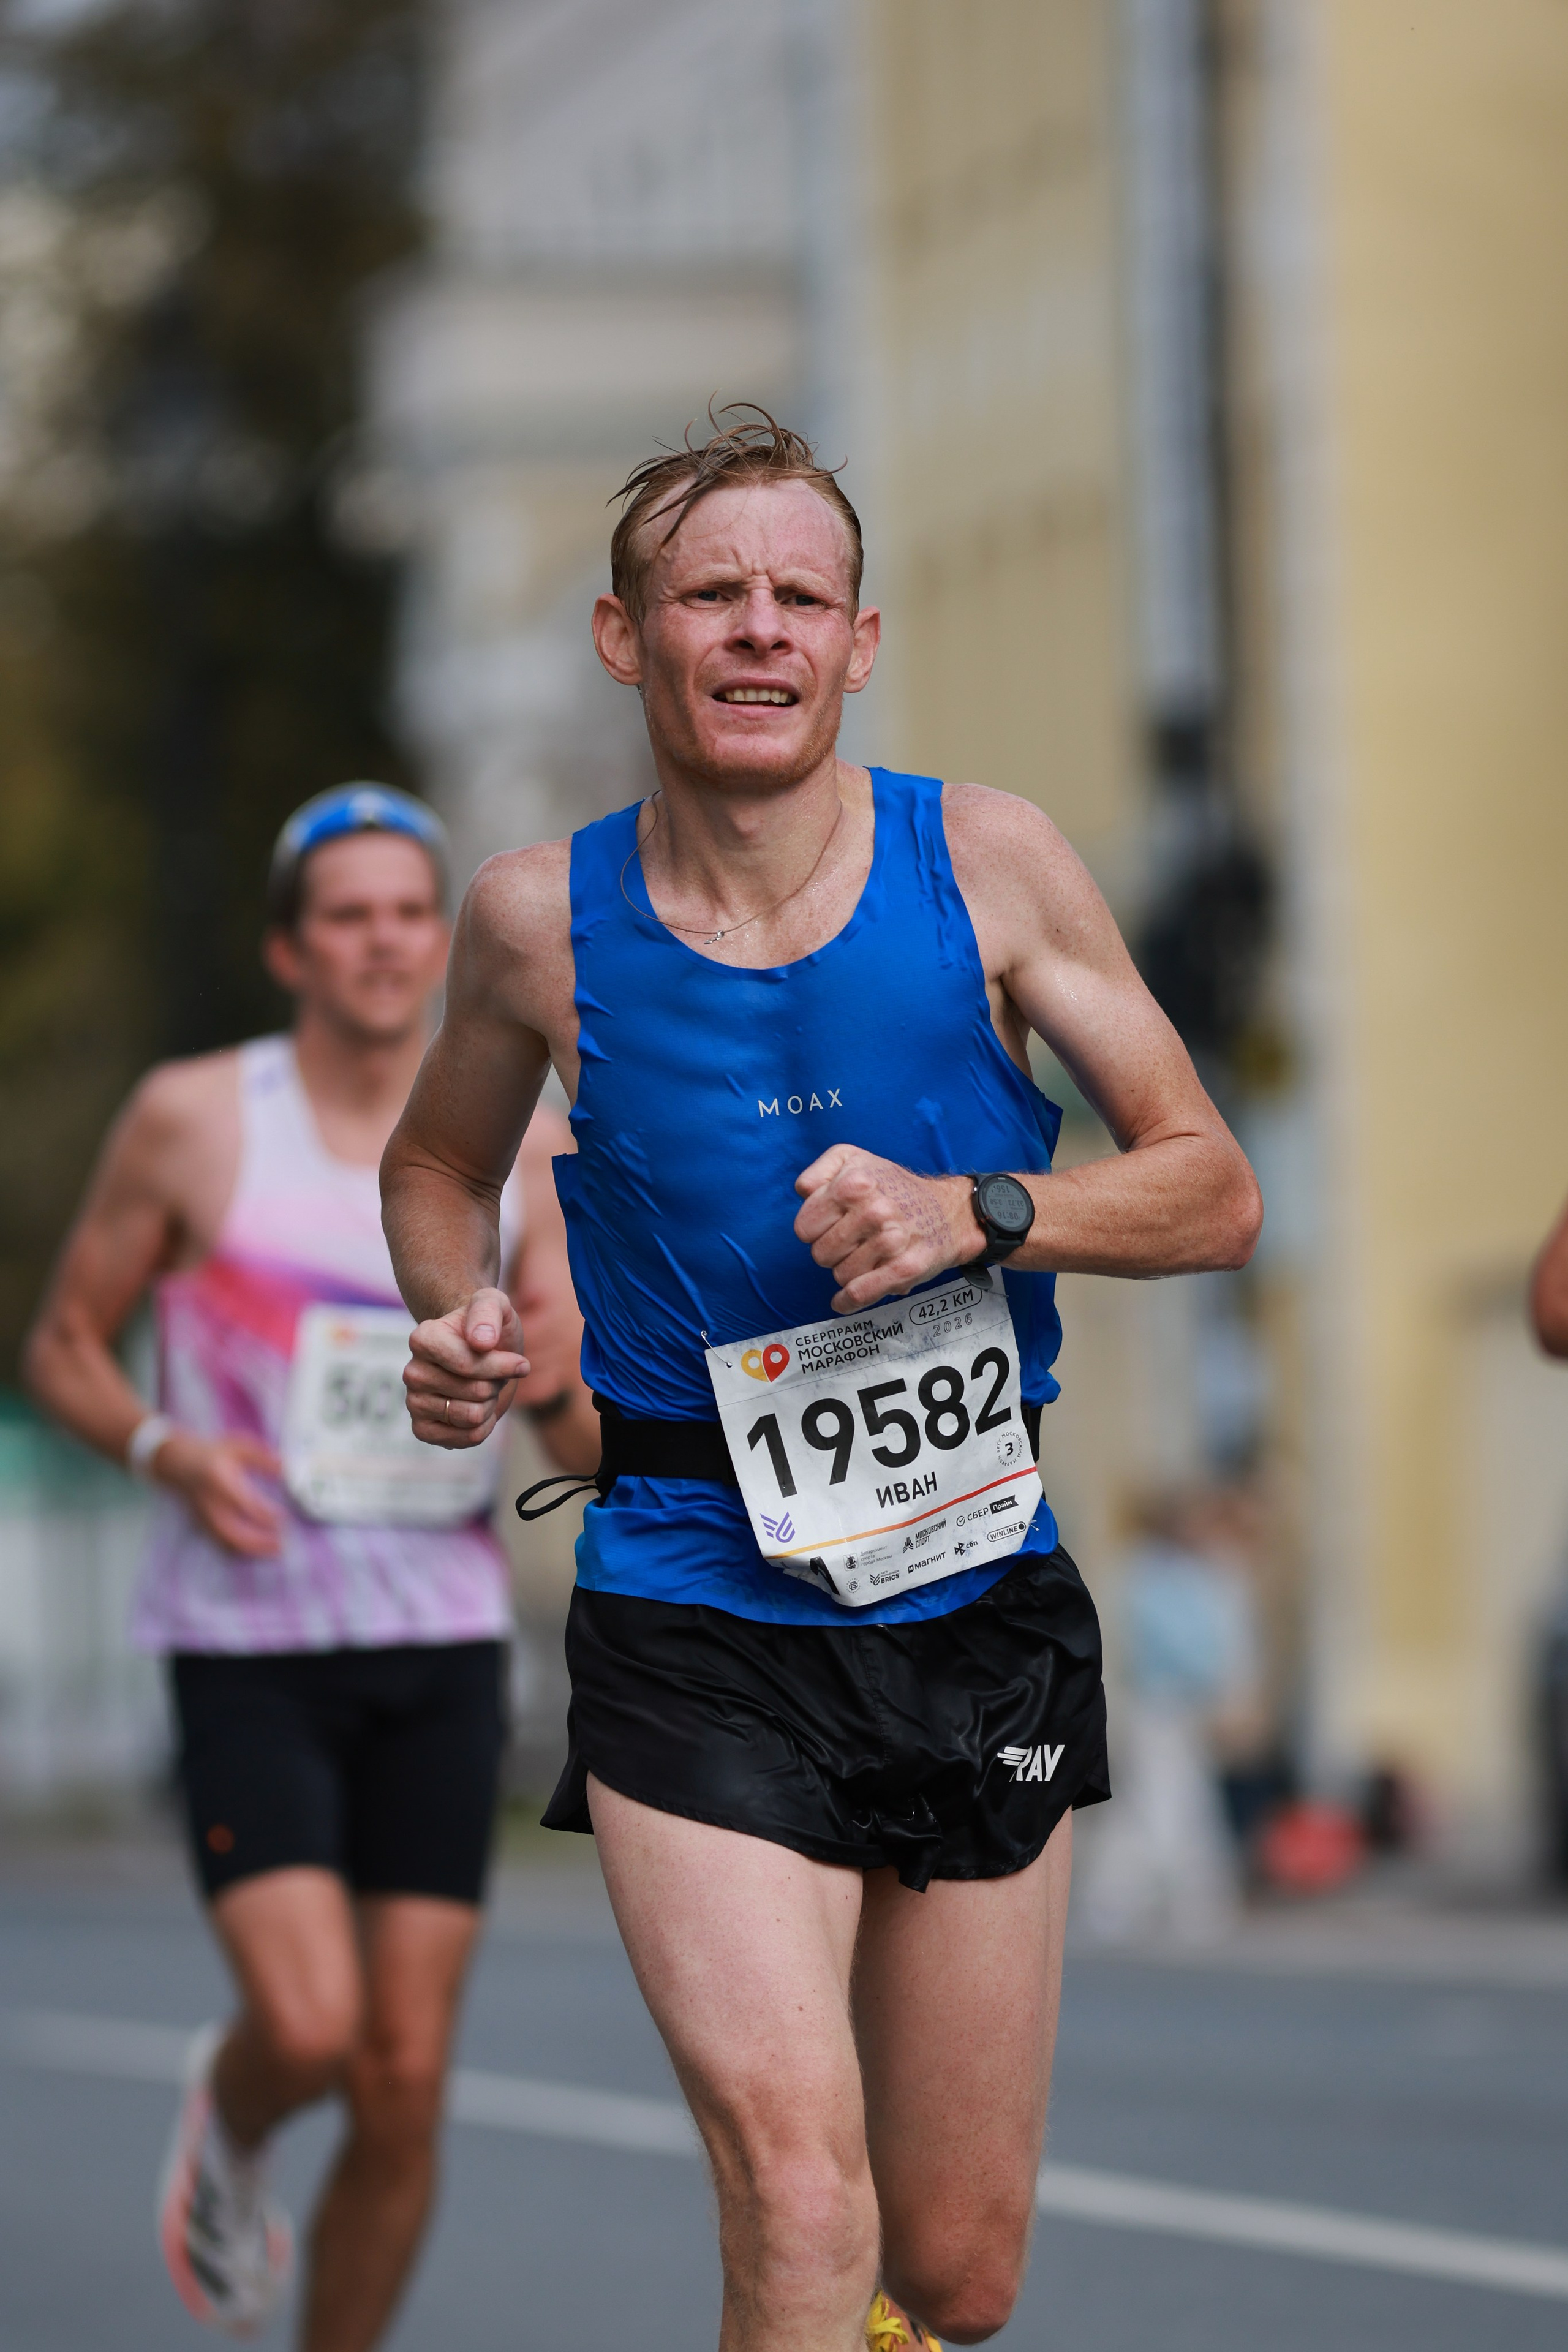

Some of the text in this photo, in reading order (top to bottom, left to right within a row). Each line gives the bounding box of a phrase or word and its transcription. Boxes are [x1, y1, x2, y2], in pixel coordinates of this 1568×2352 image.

[758, 1088, 843, 1118] MOAX
[919, 1299, 948, 1318] 42,2
[796, 1319, 873, 1346] СБЕРПРАЙМ
[933, 1313, 973, 1337] 2026
[798, 1321, 904, 1361] МОСКОВСКИЙ
[801, 1344, 880, 1374] МАРАФОН
[747, 1347, 1011, 1498] 19582
[1005, 1442, 1014, 1457] 3
[875, 1471, 937, 1509] ИВАН
[967, 1500, 1013, 1521] СБЕР Прайм
[915, 1518, 946, 1540] МОСКОВСКИЙ
[990, 1525, 1018, 1540] WINLINE
[915, 1535, 930, 1548] СПОРТ
[881, 1573, 899, 1584] BRICS
[997, 1744, 1065, 1782] RAY
